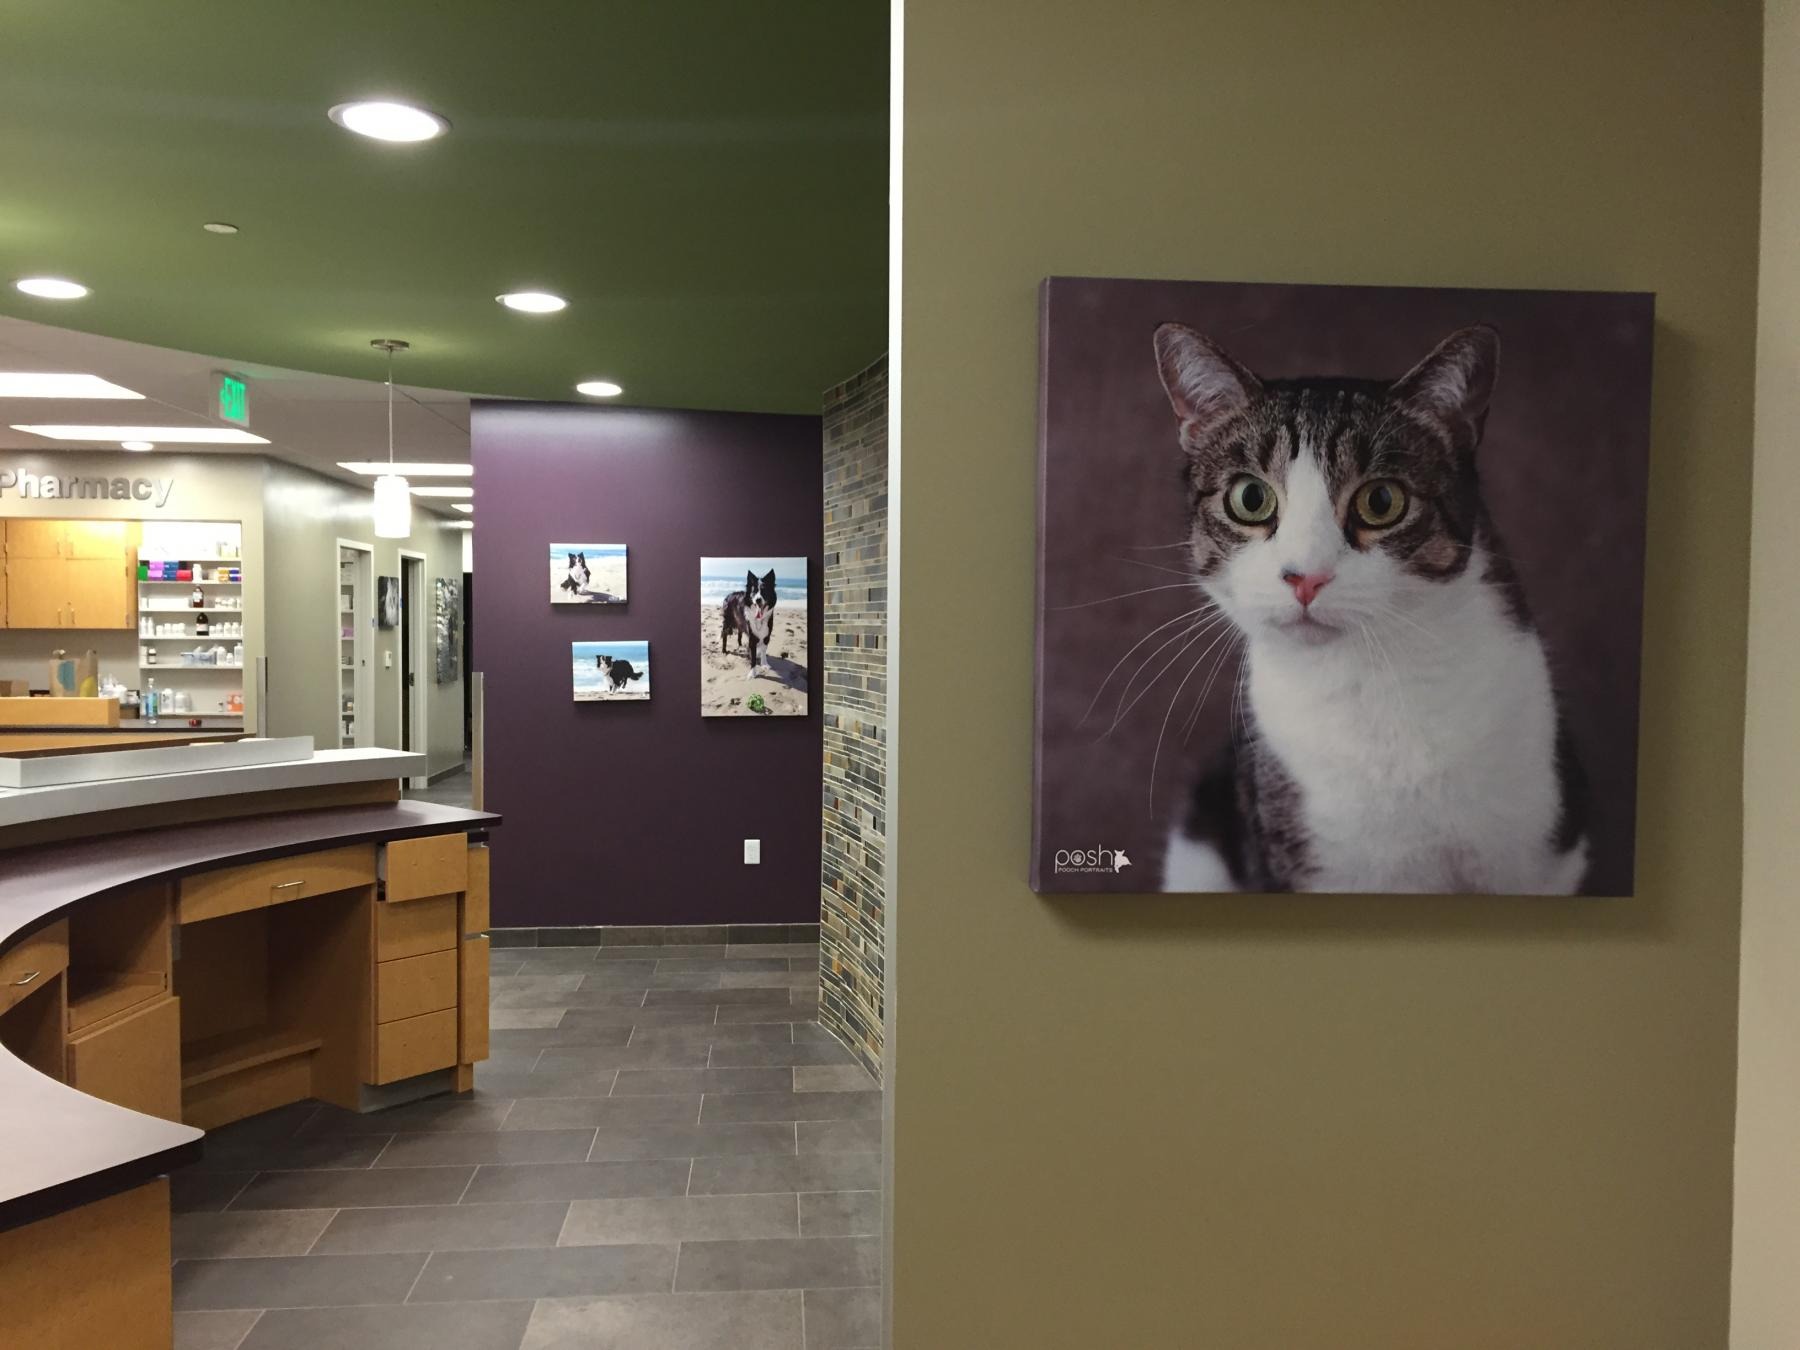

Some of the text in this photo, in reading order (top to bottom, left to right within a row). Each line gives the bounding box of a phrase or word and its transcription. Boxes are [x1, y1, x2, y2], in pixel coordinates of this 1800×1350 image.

[224, 377, 246, 421] EXIT
[0, 468, 174, 508] Pharmacy
[1054, 844, 1114, 874] posh
